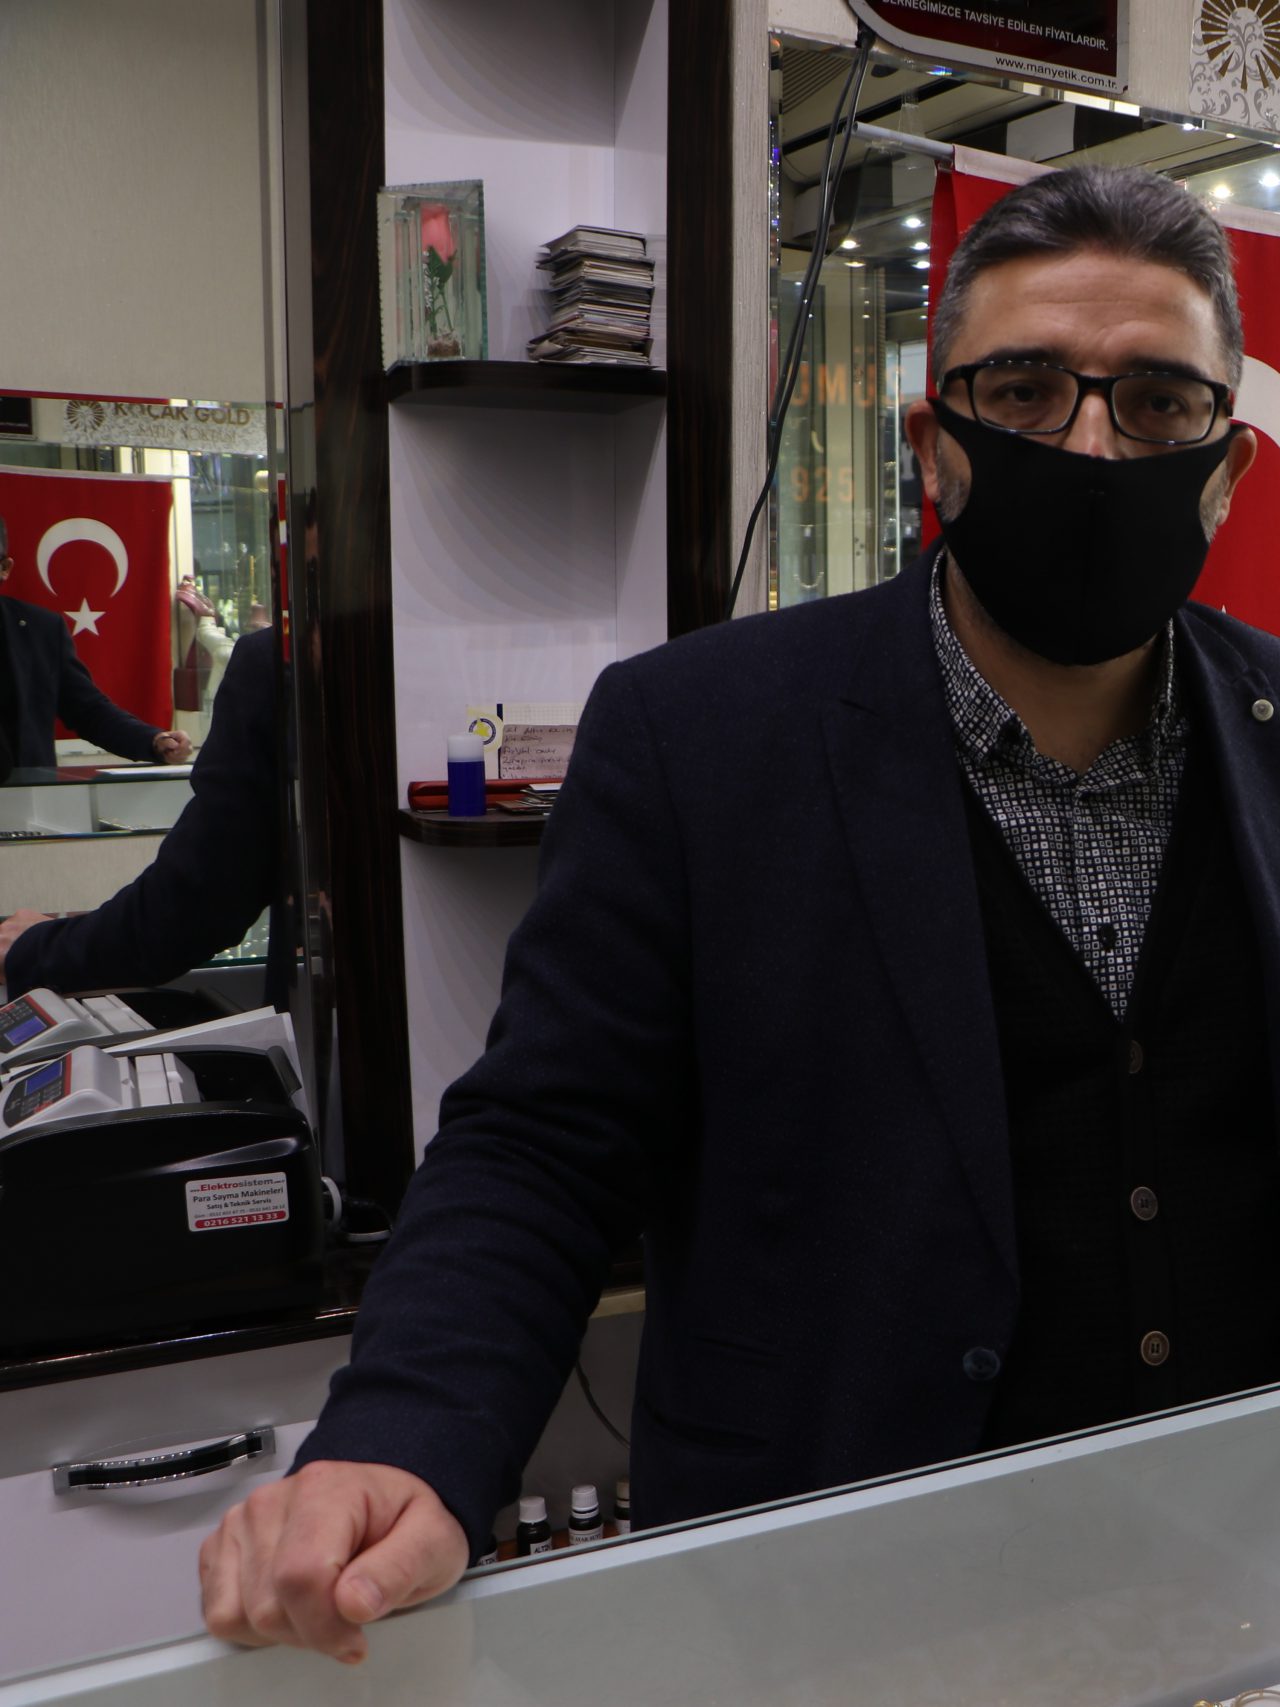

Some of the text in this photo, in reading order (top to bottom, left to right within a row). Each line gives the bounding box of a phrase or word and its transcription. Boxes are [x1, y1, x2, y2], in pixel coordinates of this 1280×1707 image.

[964, 9, 1006, 28] TAVSİYE
[1007, 19, 1043, 36] EDİLEN
[1045, 27, 1109, 50] FİYATLARDIR.
[193, 1186, 284, 1203] Para Sayma Makineleri
[230, 1199, 251, 1207] Teknik
[252, 1197, 272, 1205] Servis
[204, 1217, 229, 1227] 0216
[231, 1215, 248, 1225] 521
[266, 1212, 278, 1220] 33
